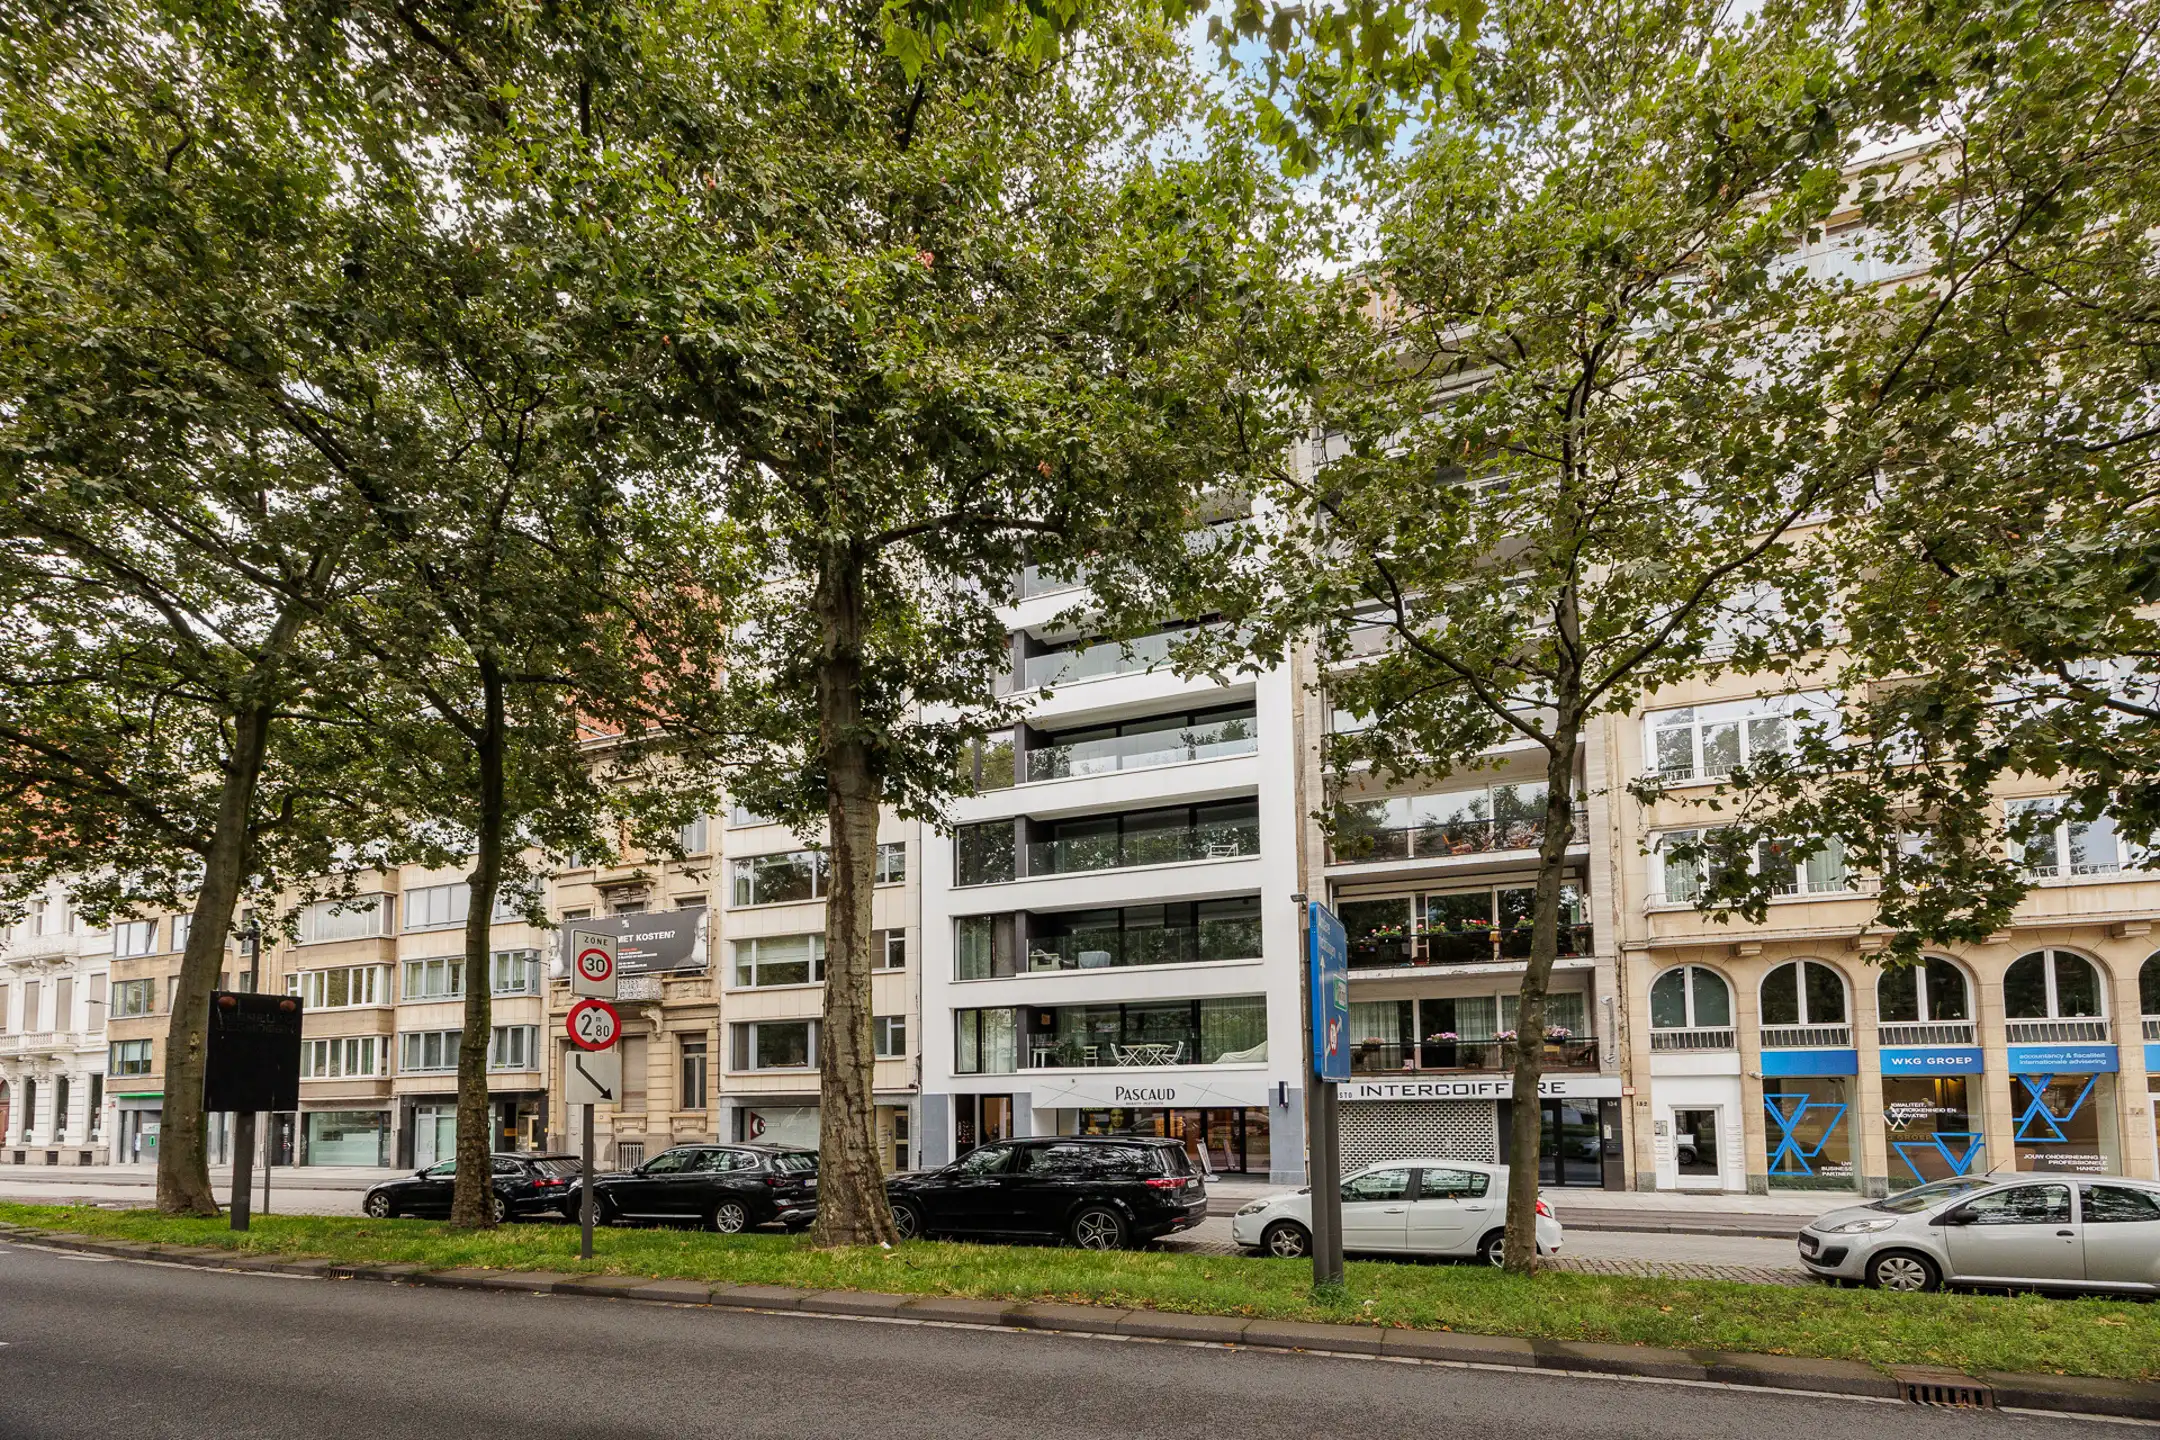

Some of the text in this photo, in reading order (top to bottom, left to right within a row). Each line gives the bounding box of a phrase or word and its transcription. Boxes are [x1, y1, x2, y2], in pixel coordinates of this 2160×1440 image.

[584, 936, 608, 947] ZONE
[636, 930, 676, 941] KOSTEN?
[585, 957, 605, 973] 30
[581, 1014, 592, 1036] 2
[596, 1025, 610, 1037] 80
[1891, 1057, 1921, 1065] WKG
[1360, 1082, 1566, 1097] INTERCOIFFRE
